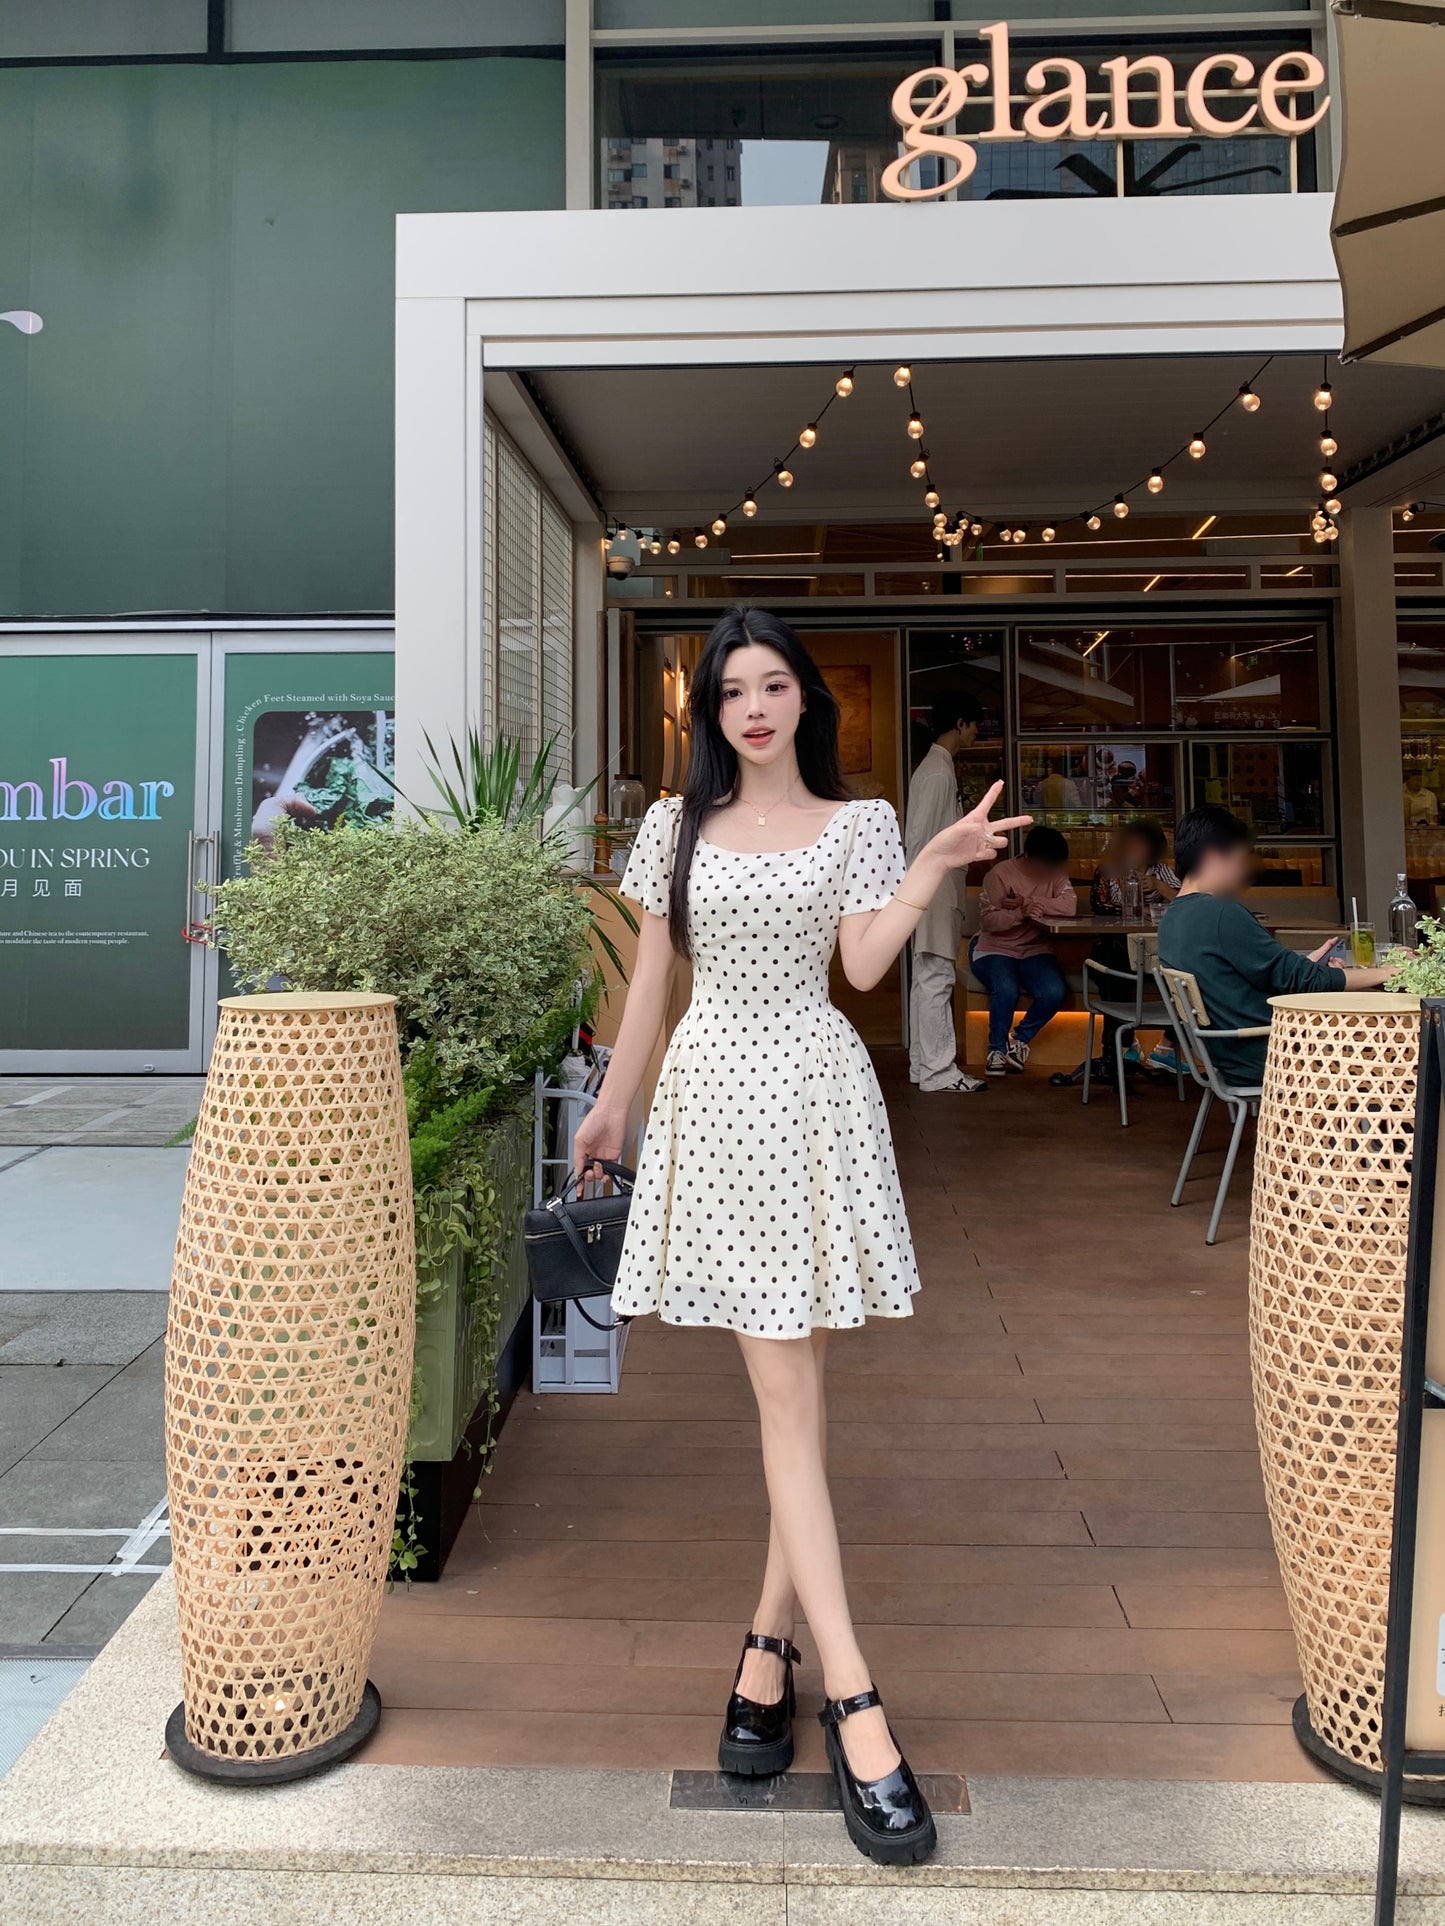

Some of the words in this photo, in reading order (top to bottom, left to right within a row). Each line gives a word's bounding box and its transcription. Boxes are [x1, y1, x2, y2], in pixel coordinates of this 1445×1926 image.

[881, 22, 1331, 200] glance
[264, 694, 284, 703] Feet
[286, 693, 326, 702] Steamed
[327, 693, 348, 702] with
[350, 693, 372, 704] Soya
[236, 699, 262, 732] Chicken
[235, 738, 246, 785] Dumpling
[0, 757, 174, 821] mbar
[233, 787, 243, 837] Mushroom
[31, 848, 54, 868] IN
[60, 848, 150, 868] SPRING
[232, 849, 242, 879] ruffle
[1, 879, 82, 897] 月见面
